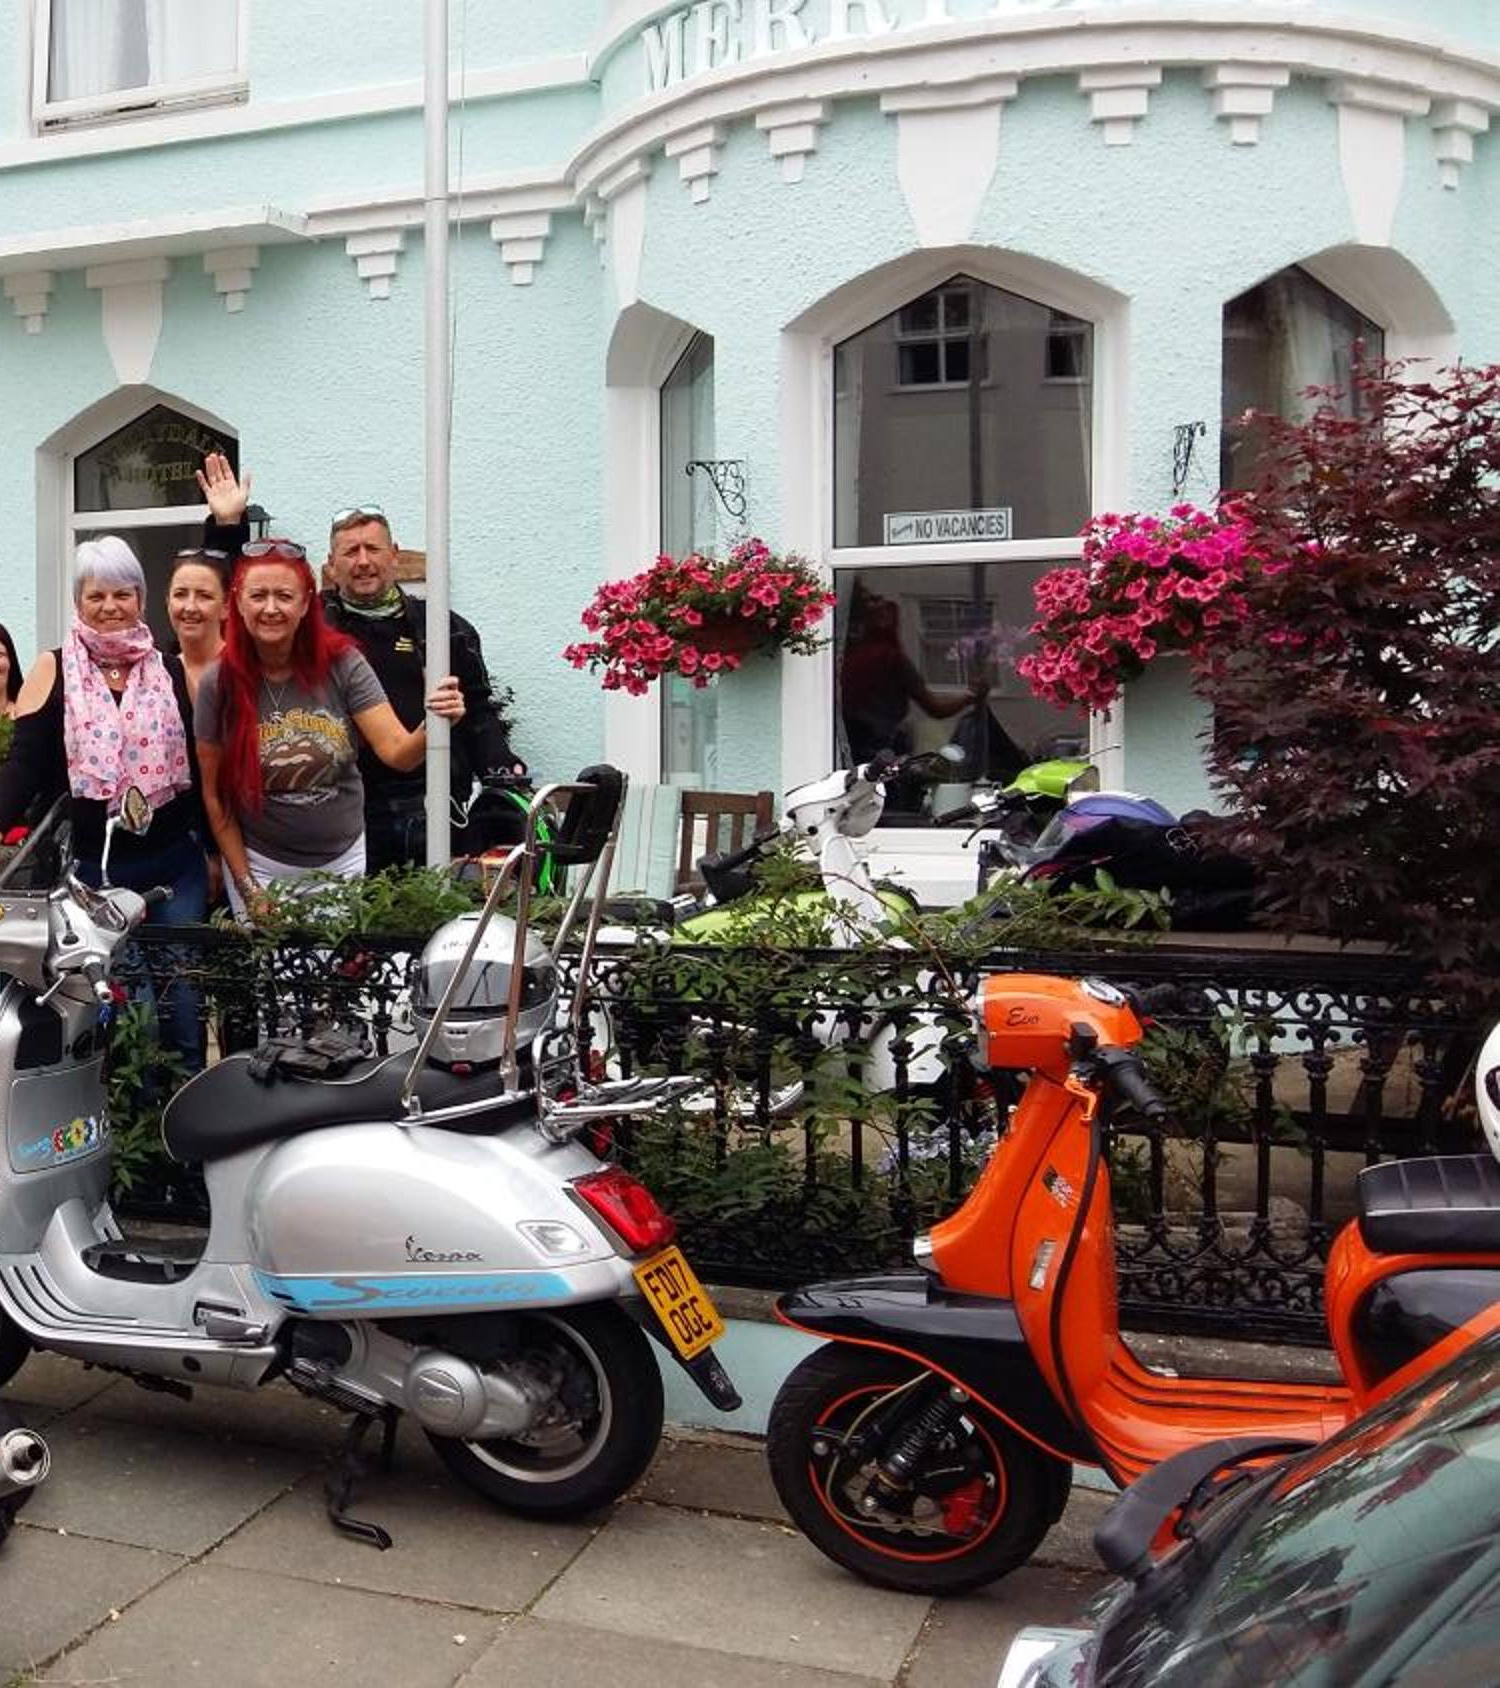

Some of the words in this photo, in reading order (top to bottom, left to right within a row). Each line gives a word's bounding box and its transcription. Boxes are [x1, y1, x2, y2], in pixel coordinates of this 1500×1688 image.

[915, 518, 933, 539] NO
[936, 514, 1005, 537] VACANCIES
[404, 1235, 485, 1263] Vespa
[643, 1257, 690, 1310] FD17
